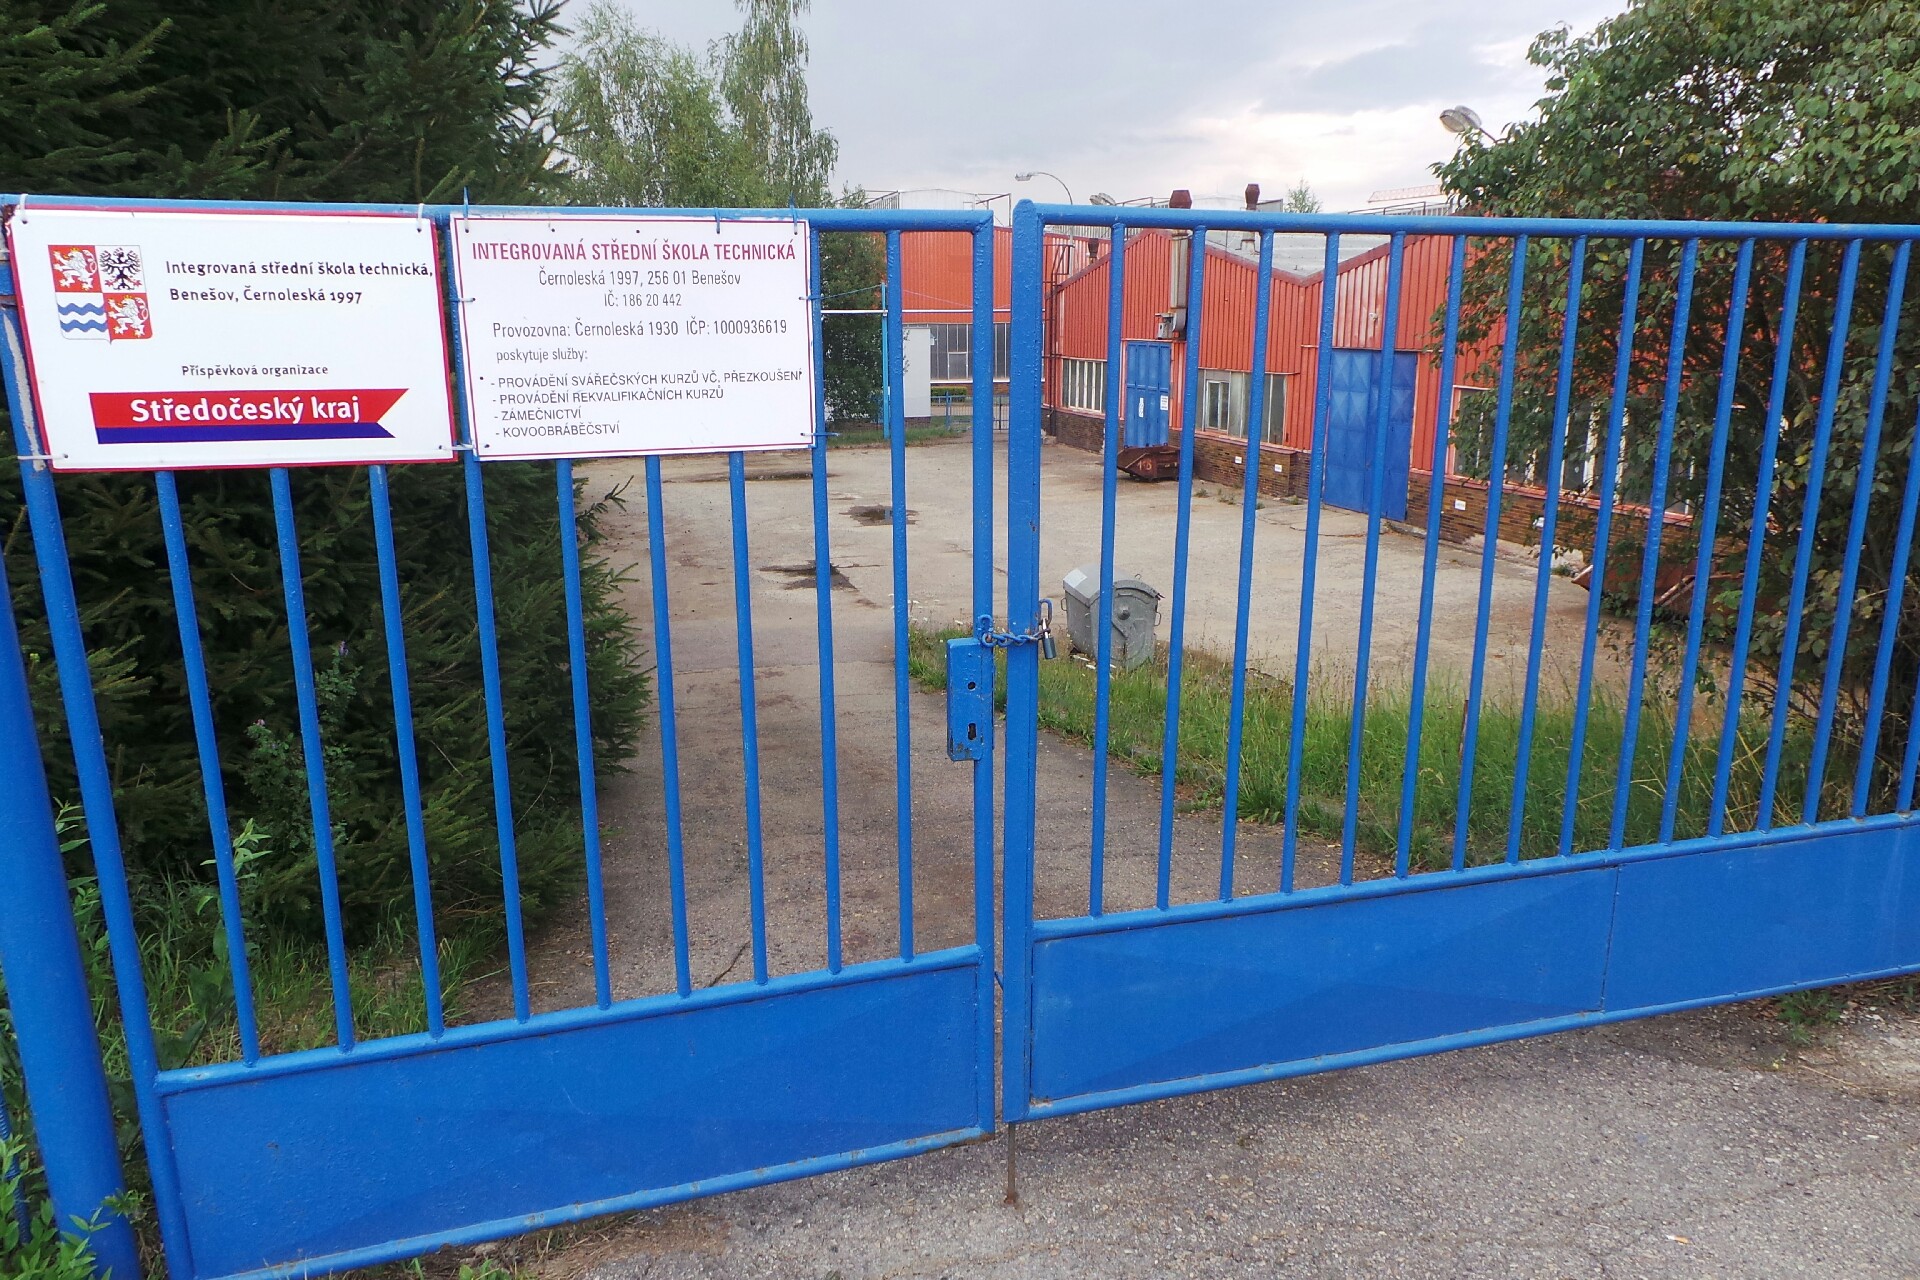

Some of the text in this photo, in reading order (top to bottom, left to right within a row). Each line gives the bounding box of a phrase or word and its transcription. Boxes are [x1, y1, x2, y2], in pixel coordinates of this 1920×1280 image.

[472, 238, 796, 260] INTEGROVANÁ STŘEDNÍ ŠKOLA TECHNICKÁ
[166, 260, 433, 277] Integrovaná střední škola technická,
[539, 265, 741, 287] Černoleská 1997, 256 01 Benešov
[170, 285, 362, 304] Benešov, Černoleská 1997
[604, 289, 681, 307] IČ: 186 20 442
[493, 315, 787, 338] Provozovna: Černoleská 1930 IČP: 1000936619
[496, 347, 588, 364] poskytuje služby:
[181, 364, 328, 379] Příspěvková organizace
[498, 372, 568, 388] PROVÁDĚNÍ
[571, 371, 657, 386] SVÁŘEČSKÝCH
[661, 369, 699, 384] KURZŮ
[701, 369, 721, 383] VČ.
[724, 367, 803, 383] PŘEZKOUŠENÍ
[499, 389, 569, 405] PROVÁDĚNÍ
[572, 387, 682, 403] REKVALIFIKAČNÍCH
[686, 384, 724, 399] KURZŮ
[131, 395, 359, 424] Středočeský kraj
[501, 405, 581, 421] ZÁMEČNICTVÍ
[503, 420, 620, 438] KOVOOBRÁBĚČSTVÍ
